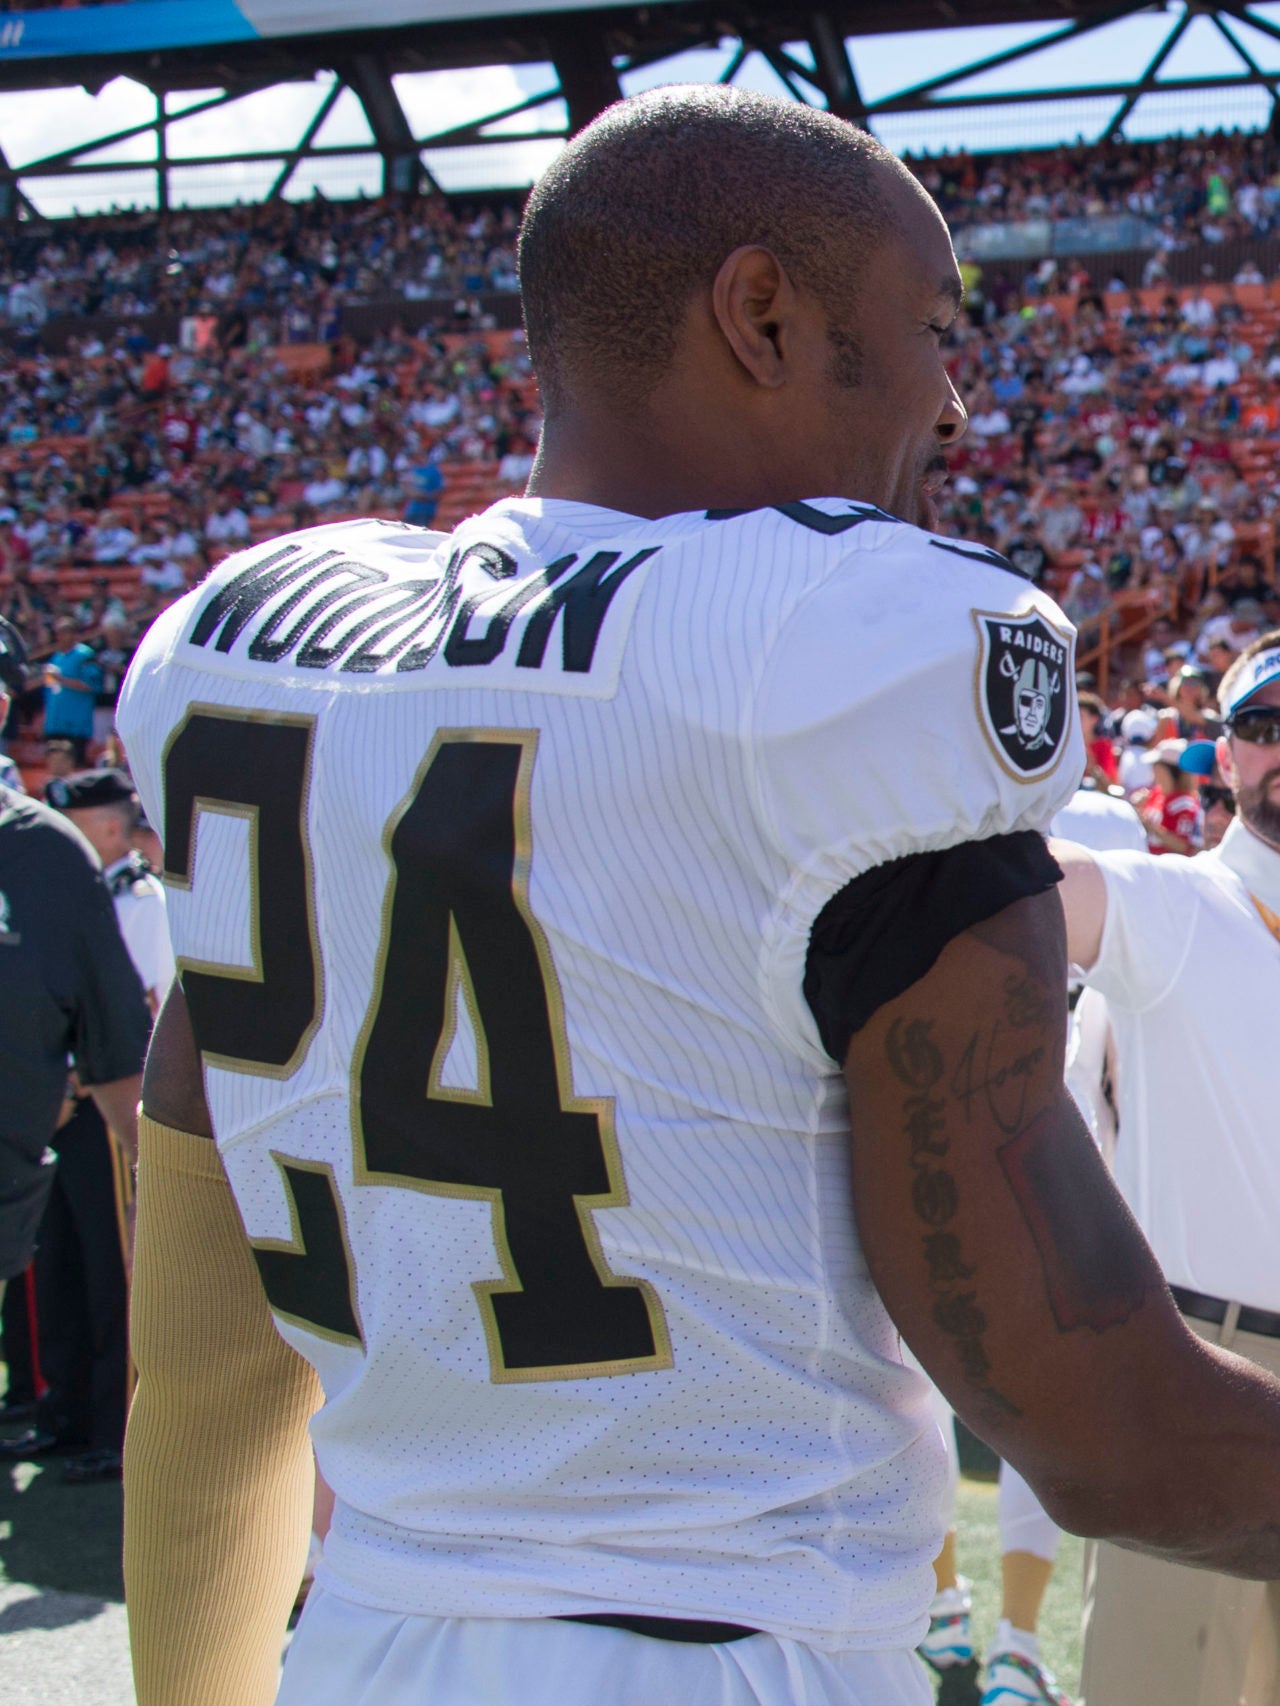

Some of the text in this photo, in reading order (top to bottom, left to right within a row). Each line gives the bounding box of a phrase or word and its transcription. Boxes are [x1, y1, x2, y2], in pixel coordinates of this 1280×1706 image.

[189, 541, 663, 674] WOODSON
[999, 626, 1064, 665] RAIDERS
[161, 700, 675, 1385] 24
